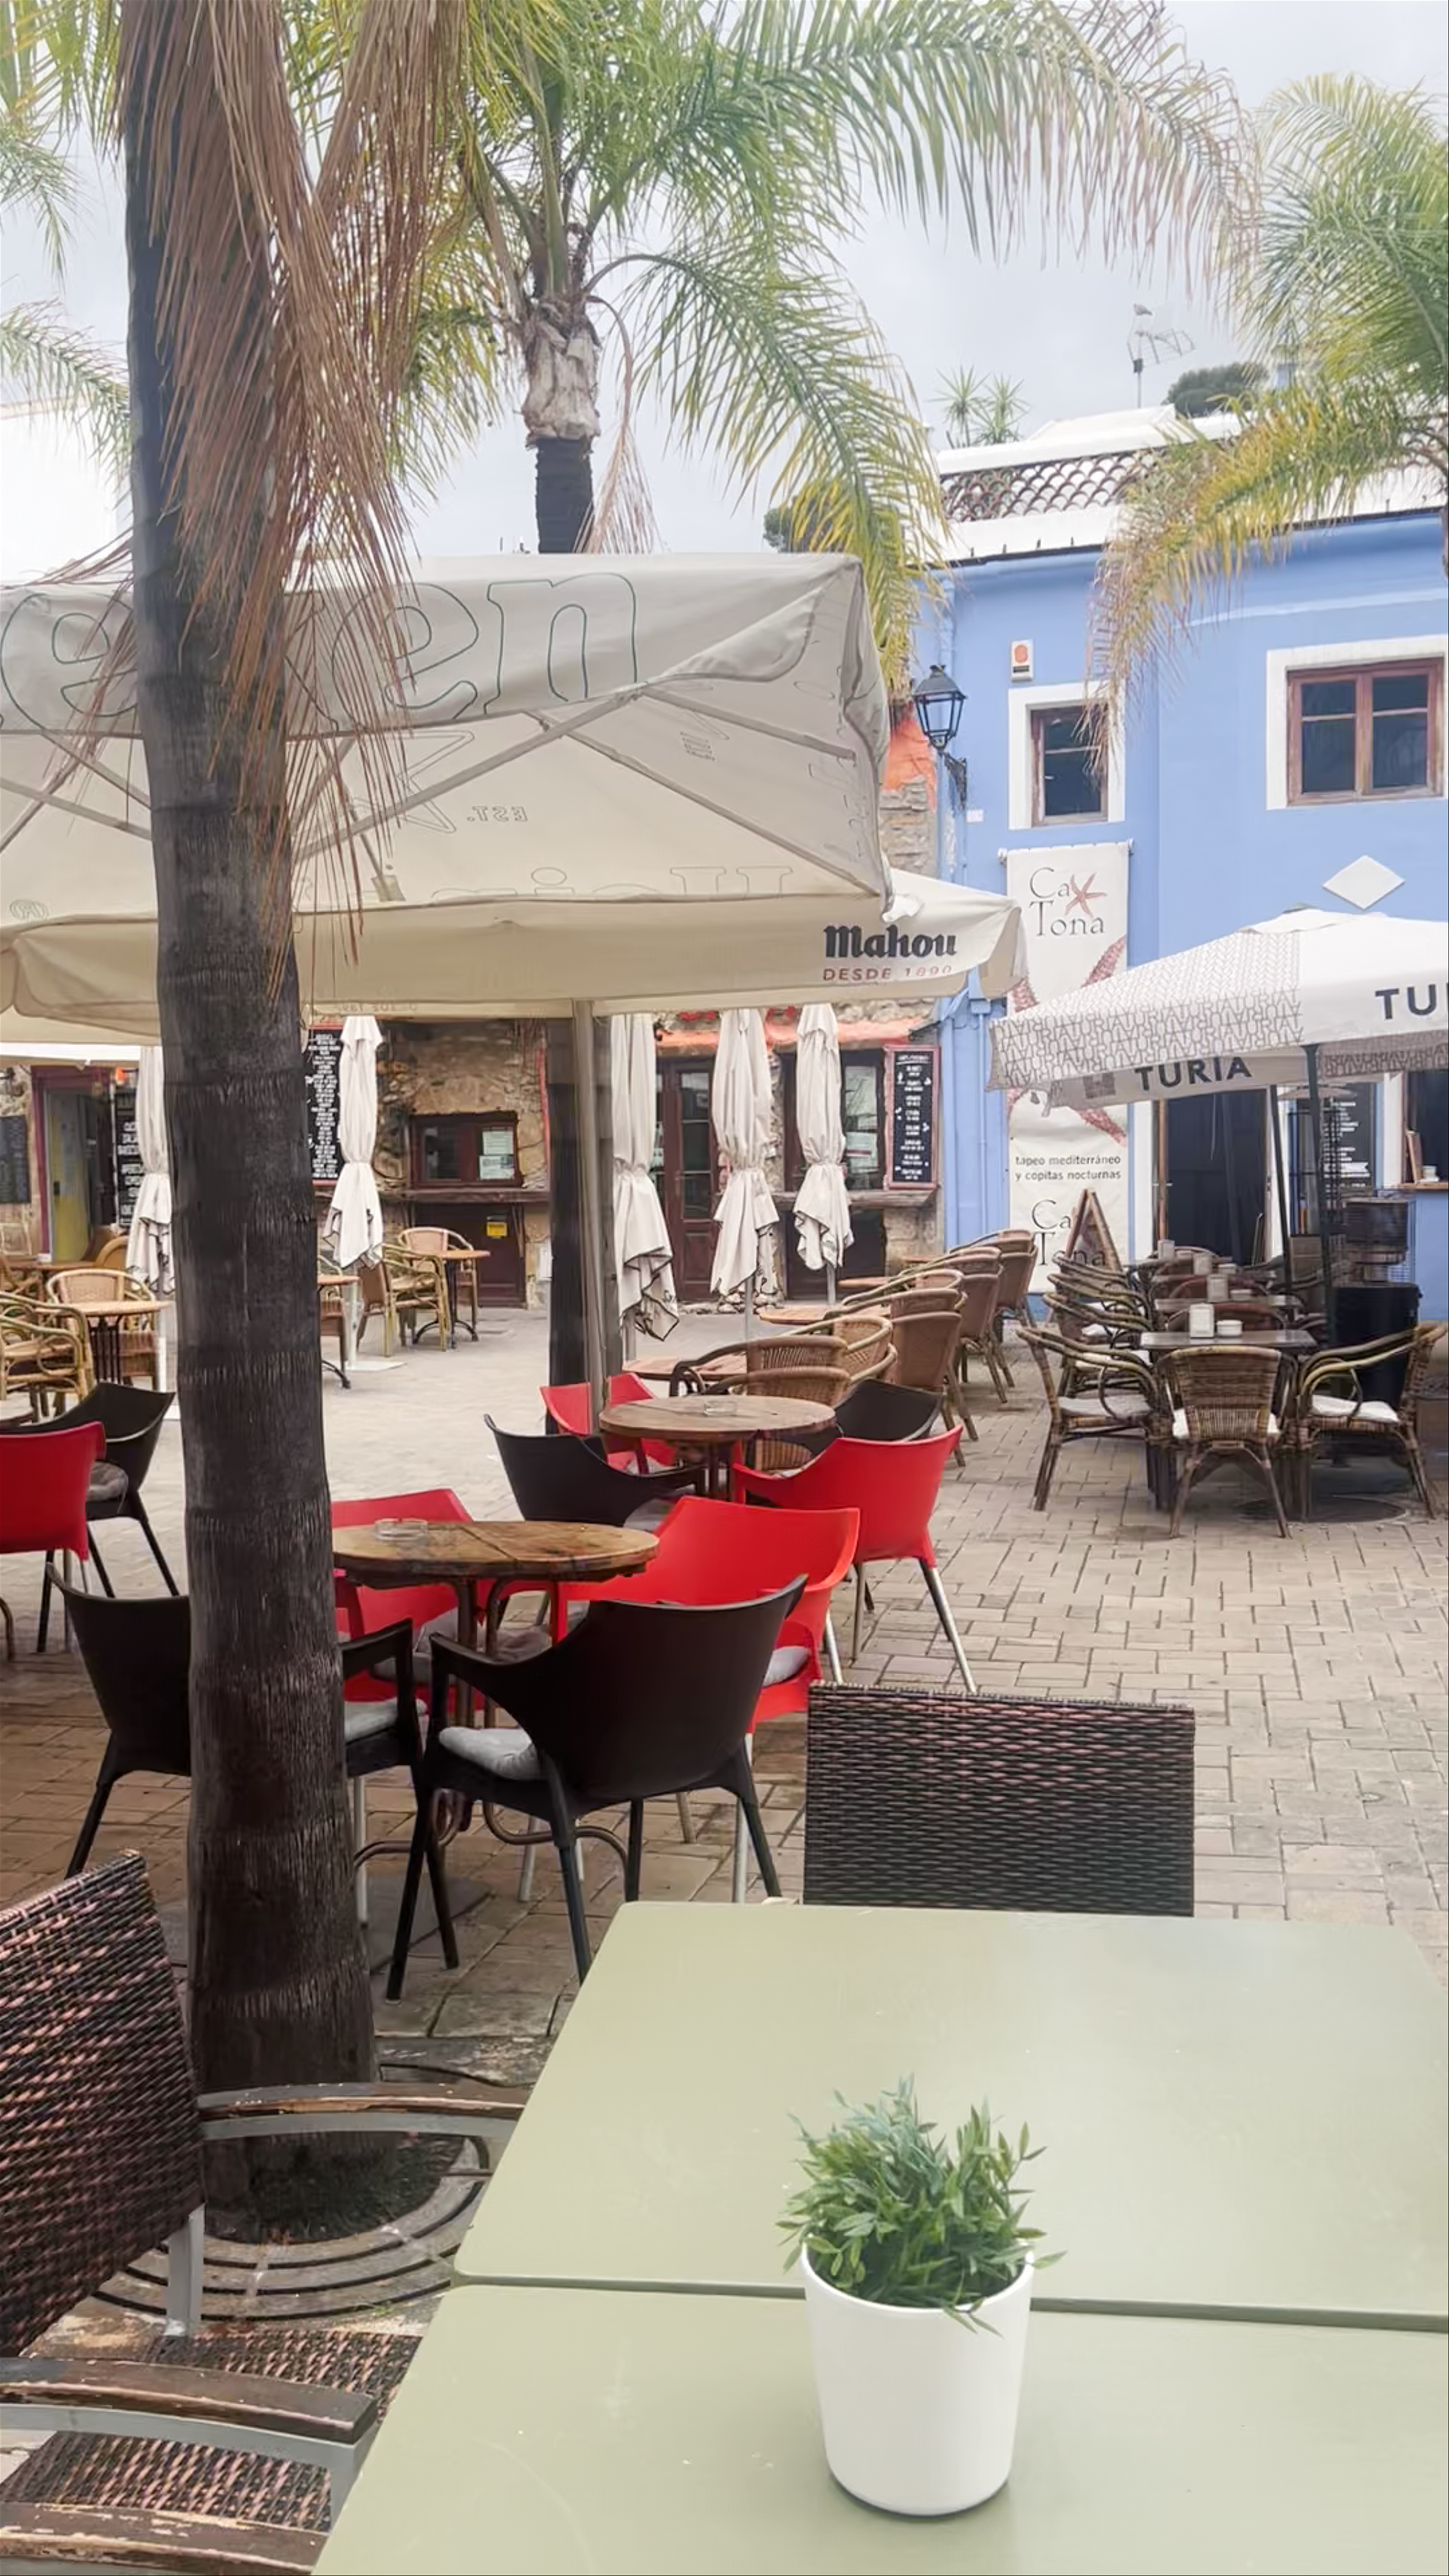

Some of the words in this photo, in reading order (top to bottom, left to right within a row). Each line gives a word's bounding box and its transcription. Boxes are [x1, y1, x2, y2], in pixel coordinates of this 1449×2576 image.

[1029, 867, 1070, 898] Ca
[1029, 900, 1105, 937] Tona
[823, 924, 957, 958] Mahou
[823, 967, 891, 981] DESDE
[1375, 983, 1449, 1020] TU
[1135, 1055, 1252, 1092] TURIA
[1015, 1157, 1045, 1166] tapeo
[1049, 1155, 1121, 1164] mediterráneo
[1015, 1173, 1021, 1181] y
[1025, 1172, 1063, 1181] copitas
[1067, 1170, 1121, 1179] nocturnas
[1032, 1200, 1071, 1229] Ca
